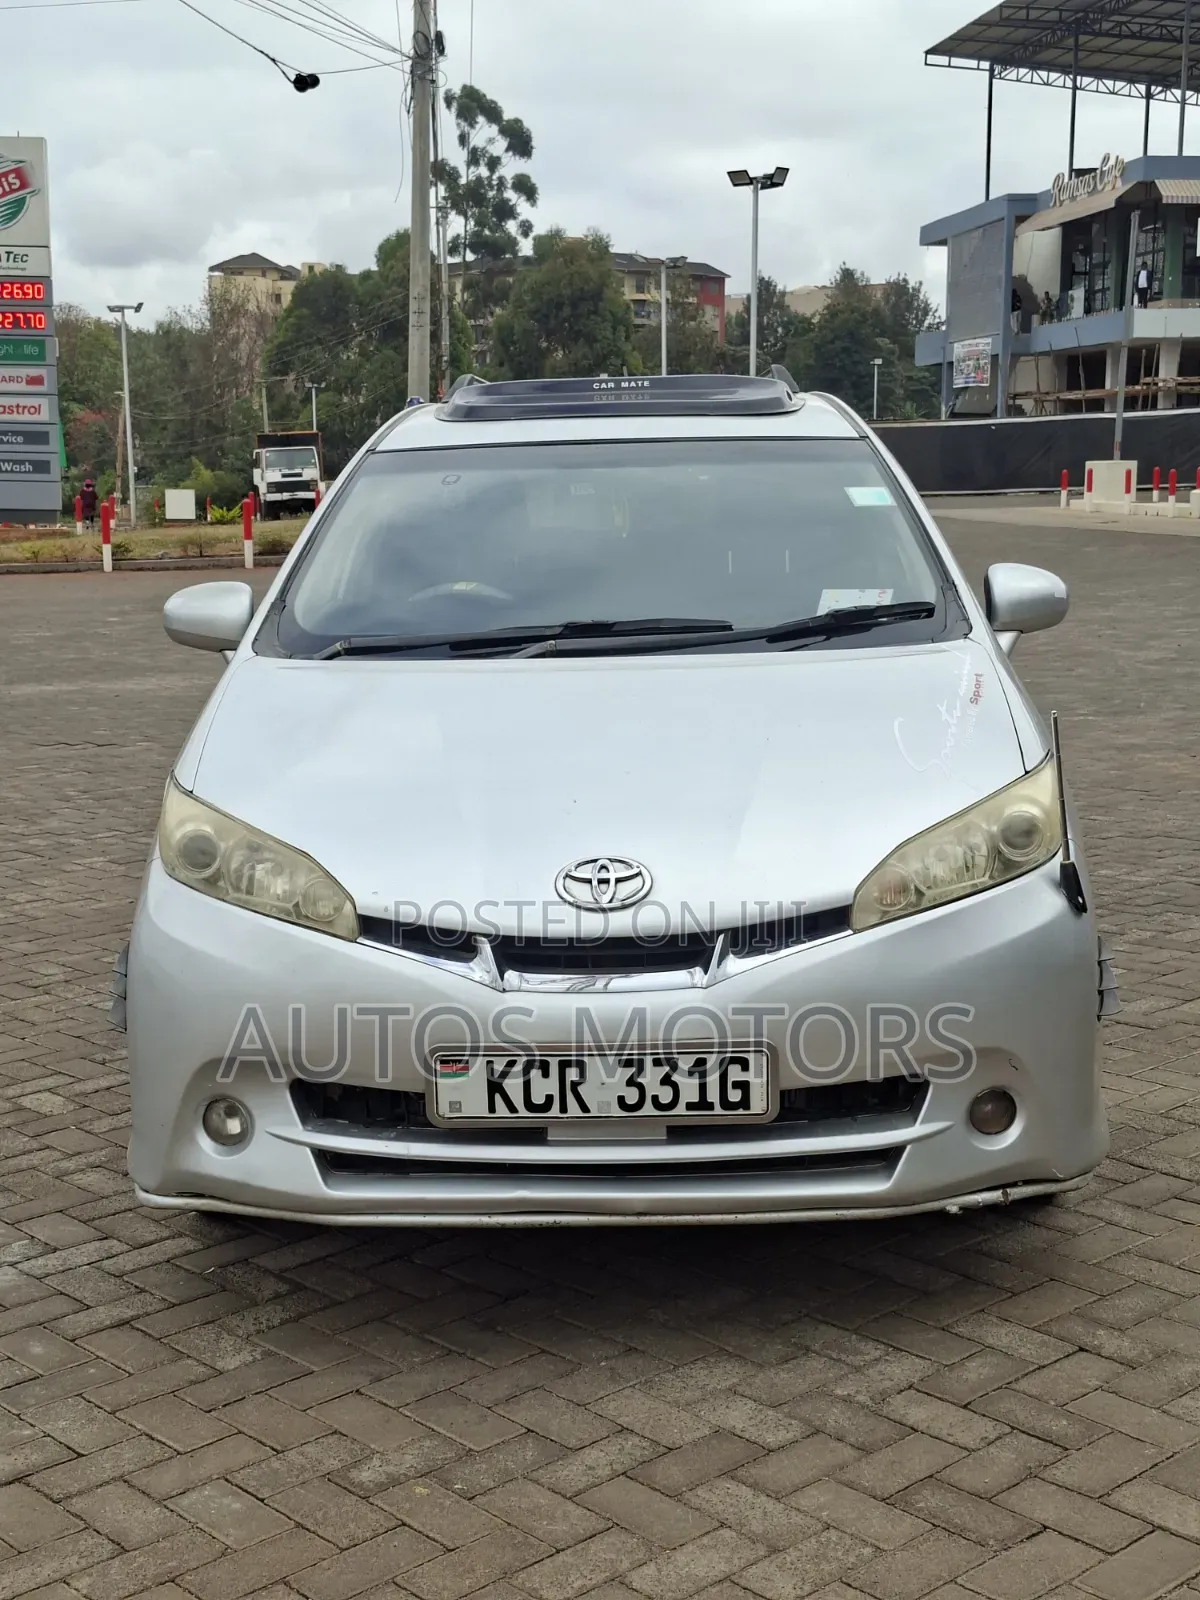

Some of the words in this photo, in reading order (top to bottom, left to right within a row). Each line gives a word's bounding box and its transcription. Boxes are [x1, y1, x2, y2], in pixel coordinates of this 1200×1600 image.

[0, 283, 44, 299] 26.90
[621, 380, 650, 388] MATE
[0, 462, 33, 472] Wash
[486, 1058, 592, 1115] KCR
[617, 1055, 751, 1113] 331G
